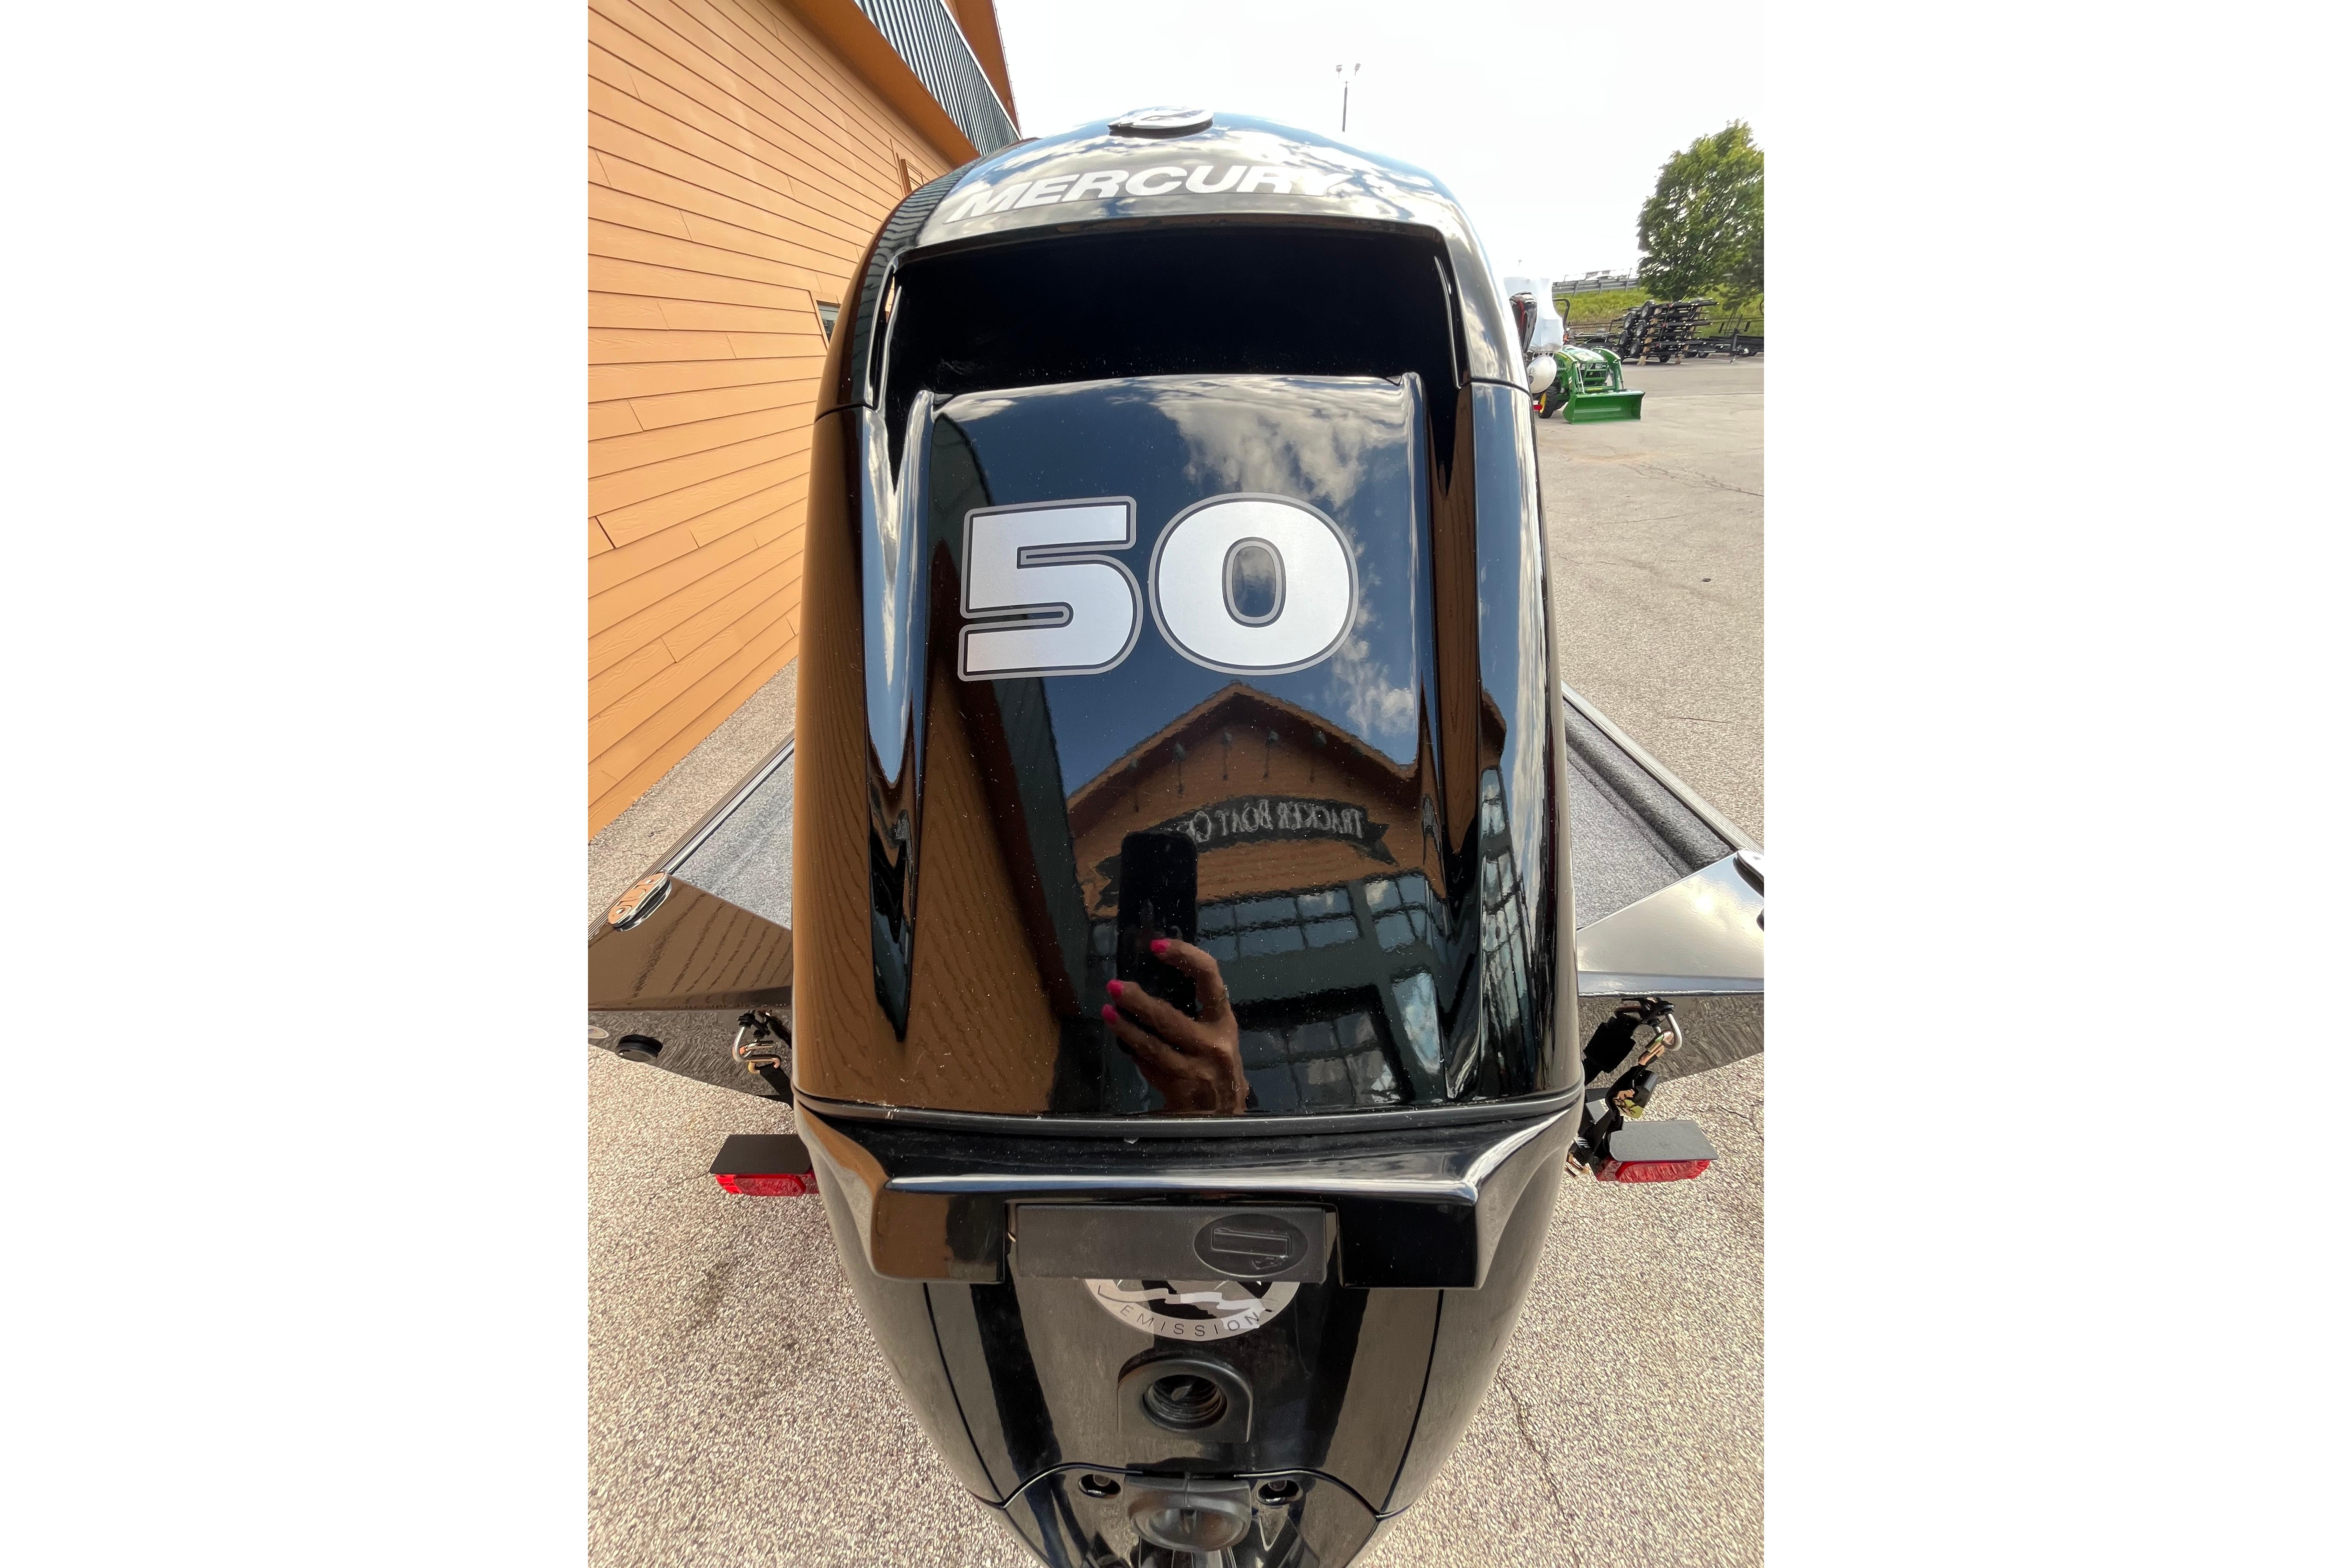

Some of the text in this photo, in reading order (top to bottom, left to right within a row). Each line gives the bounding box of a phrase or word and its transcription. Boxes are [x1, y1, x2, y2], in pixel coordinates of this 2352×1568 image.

[946, 164, 1353, 223] MERCURY
[957, 492, 1359, 681] 50
[1120, 1305, 1260, 1337] EMISSION
